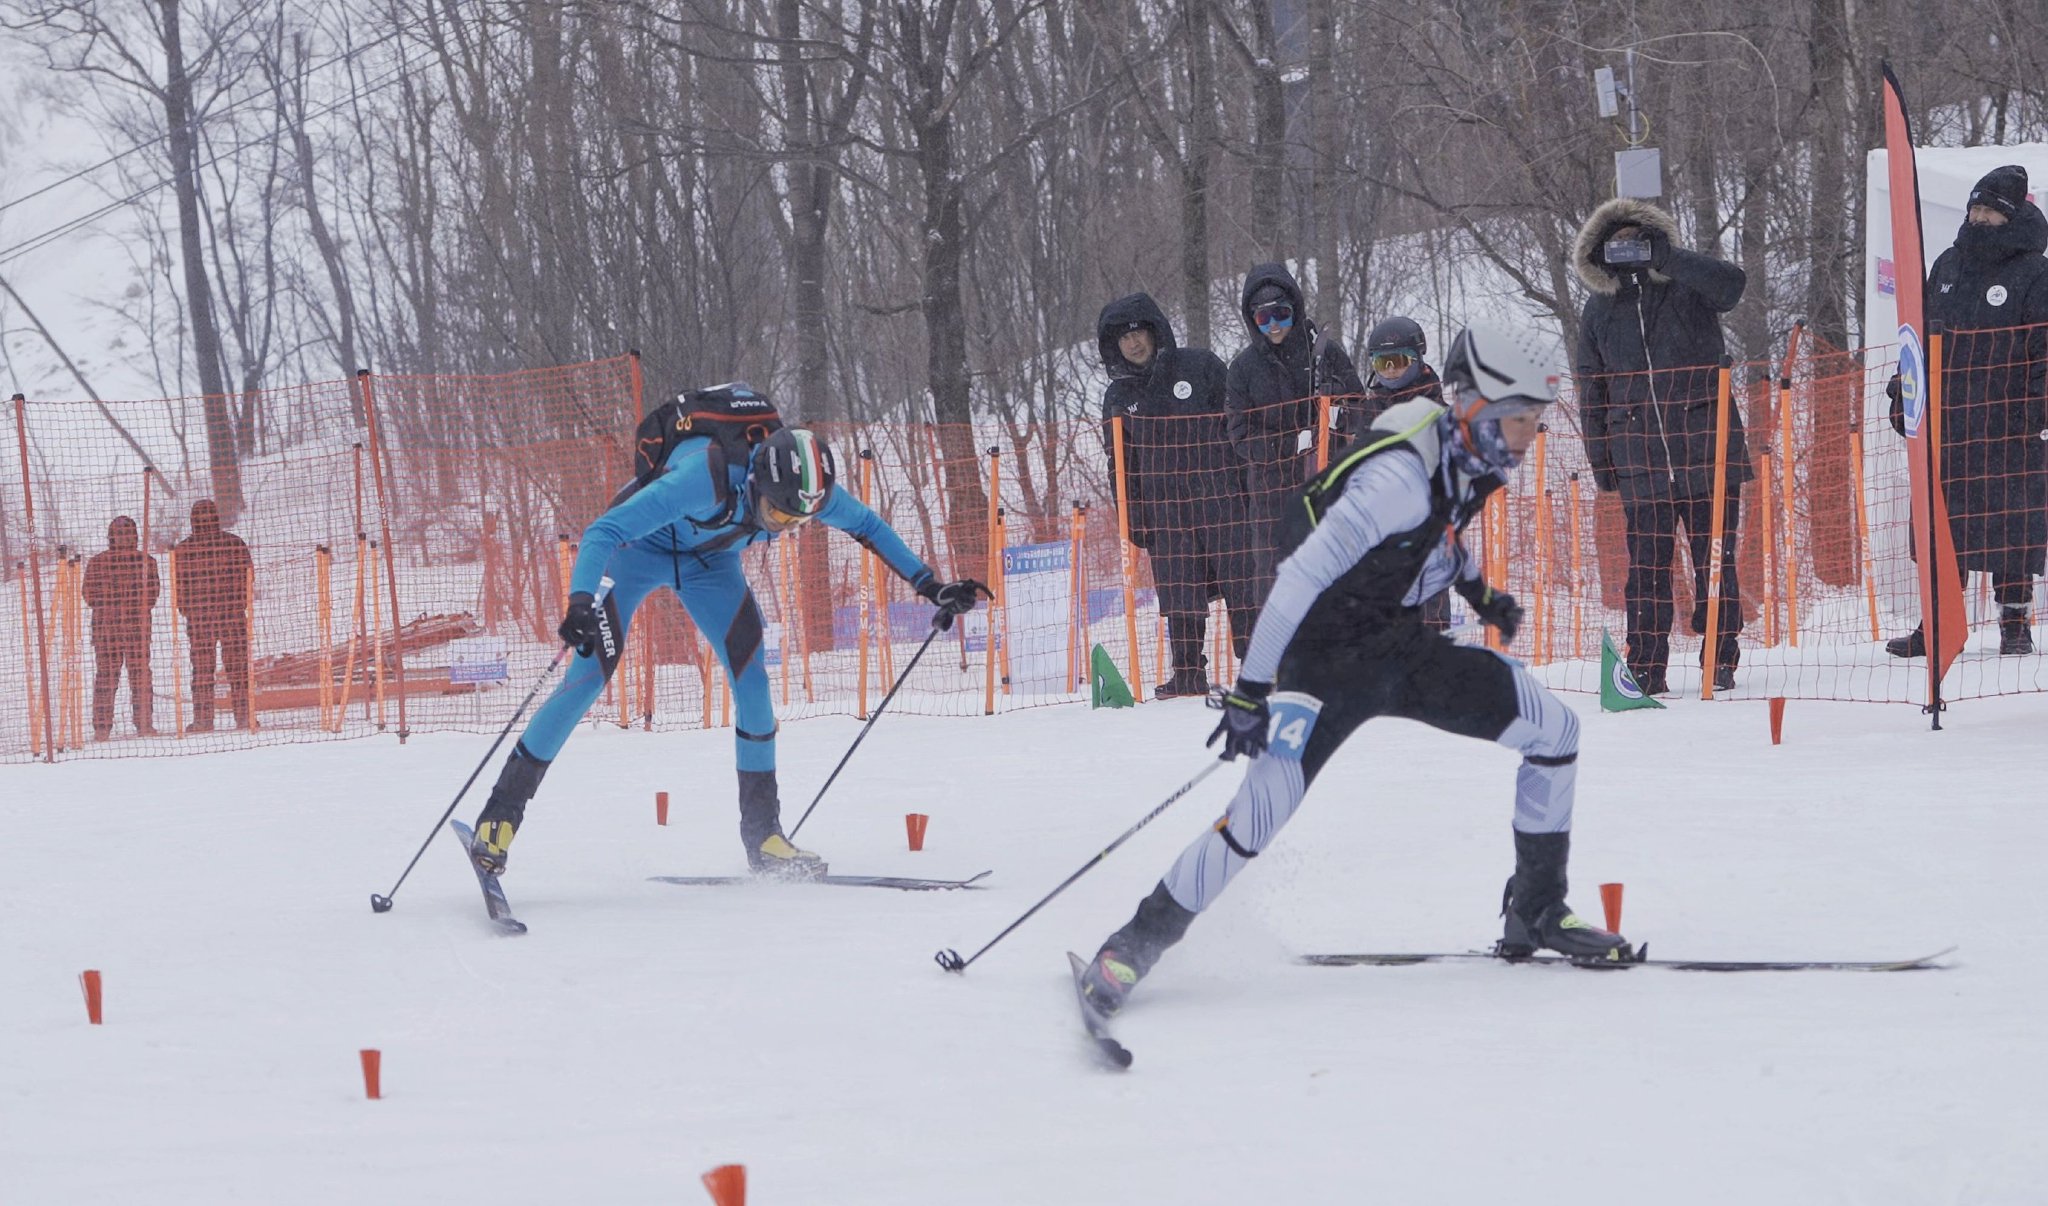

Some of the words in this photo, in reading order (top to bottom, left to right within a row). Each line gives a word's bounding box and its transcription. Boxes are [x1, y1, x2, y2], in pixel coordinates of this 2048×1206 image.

[1709, 538, 1723, 598] SPM
[860, 585, 868, 629] SPM
[1267, 711, 1307, 750] 14
